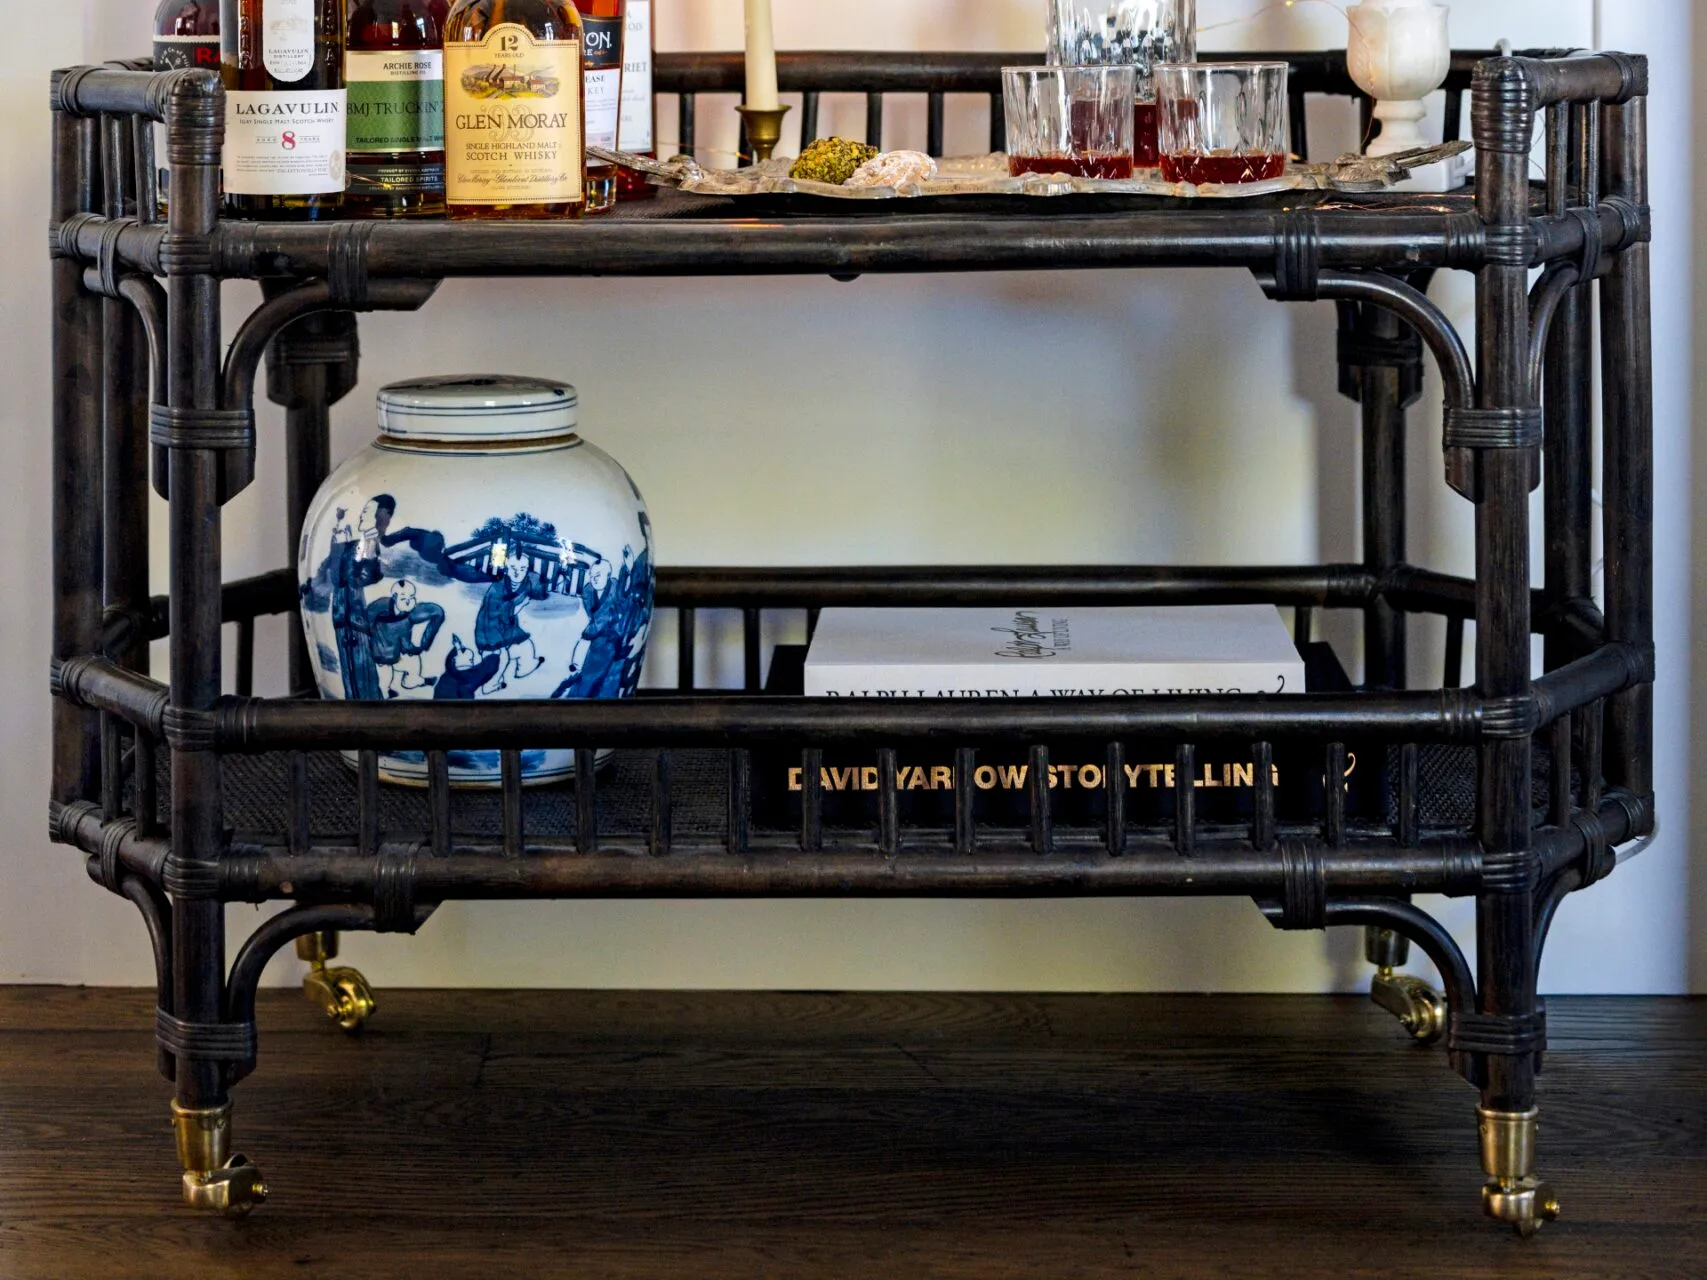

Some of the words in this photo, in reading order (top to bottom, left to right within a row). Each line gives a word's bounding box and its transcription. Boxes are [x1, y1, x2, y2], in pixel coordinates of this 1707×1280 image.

[500, 35, 518, 51] 12
[583, 31, 611, 50] ON
[383, 62, 413, 70] ARCHIE
[236, 101, 339, 115] LAGAVULIN
[456, 113, 502, 130] GLEN
[507, 113, 568, 129] MORAY
[281, 130, 296, 151] 8
[491, 142, 536, 150] HIGHLAND
[465, 152, 508, 161] SCOTCH
[514, 151, 557, 160] WHISKY
[896, 765, 1028, 790] YAROW
